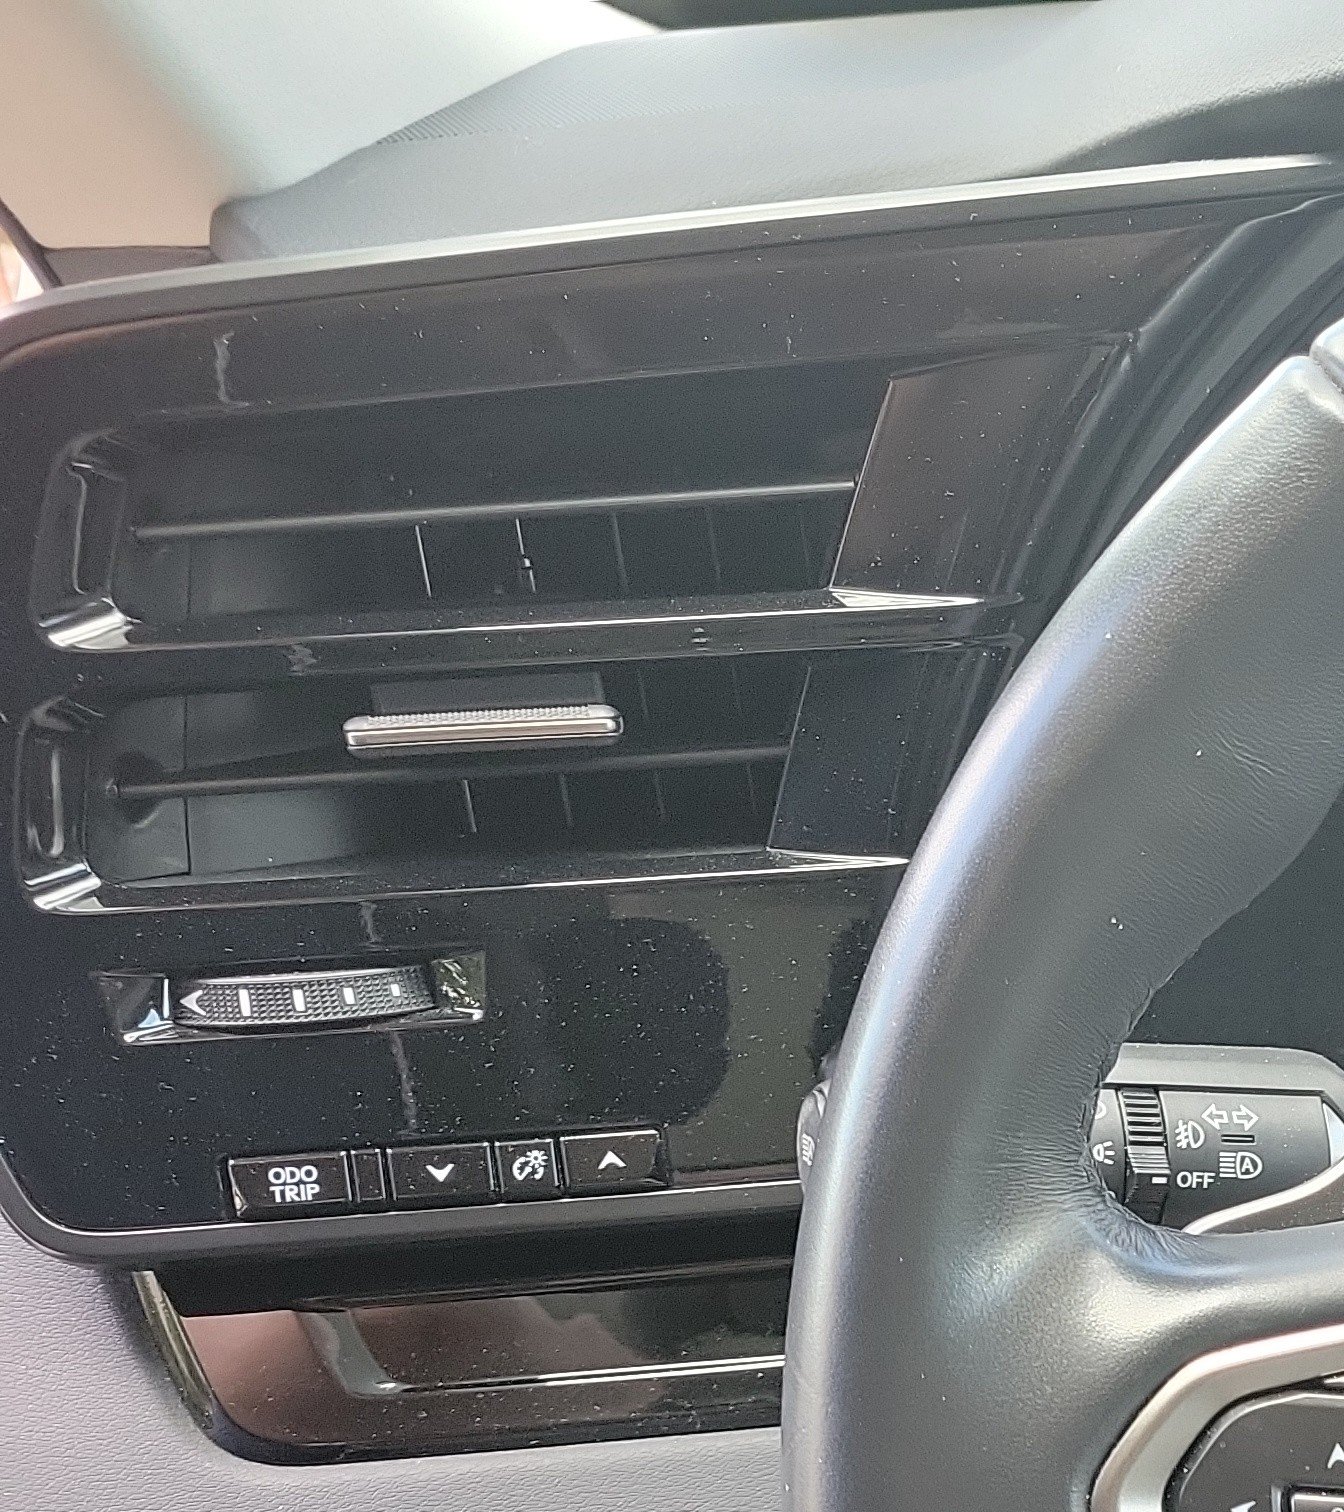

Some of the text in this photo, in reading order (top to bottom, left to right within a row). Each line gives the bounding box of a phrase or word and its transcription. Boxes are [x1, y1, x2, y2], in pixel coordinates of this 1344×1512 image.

[268, 1166, 319, 1184] ODO
[1176, 1171, 1217, 1189] OFF
[269, 1182, 321, 1203] TRIP
